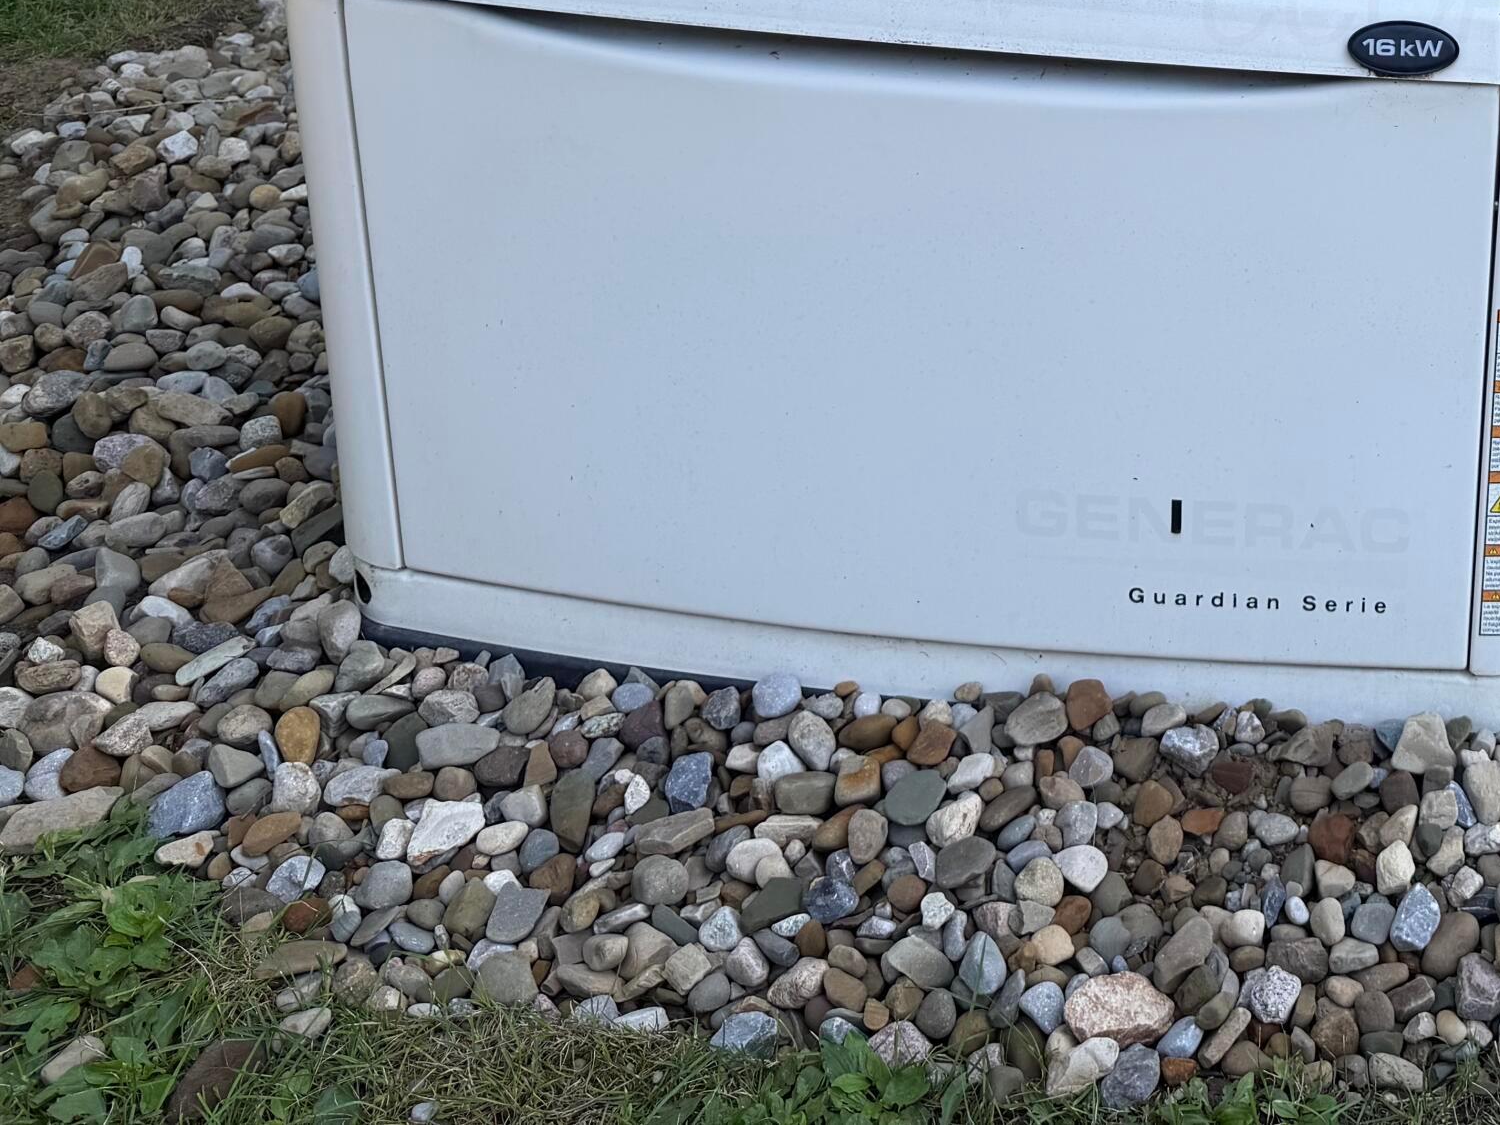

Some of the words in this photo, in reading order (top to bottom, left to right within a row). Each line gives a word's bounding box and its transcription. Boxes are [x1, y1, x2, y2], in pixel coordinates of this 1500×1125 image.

[1015, 488, 1410, 554] GENERAC
[1128, 587, 1281, 610] Guardian
[1302, 595, 1388, 614] Serie
